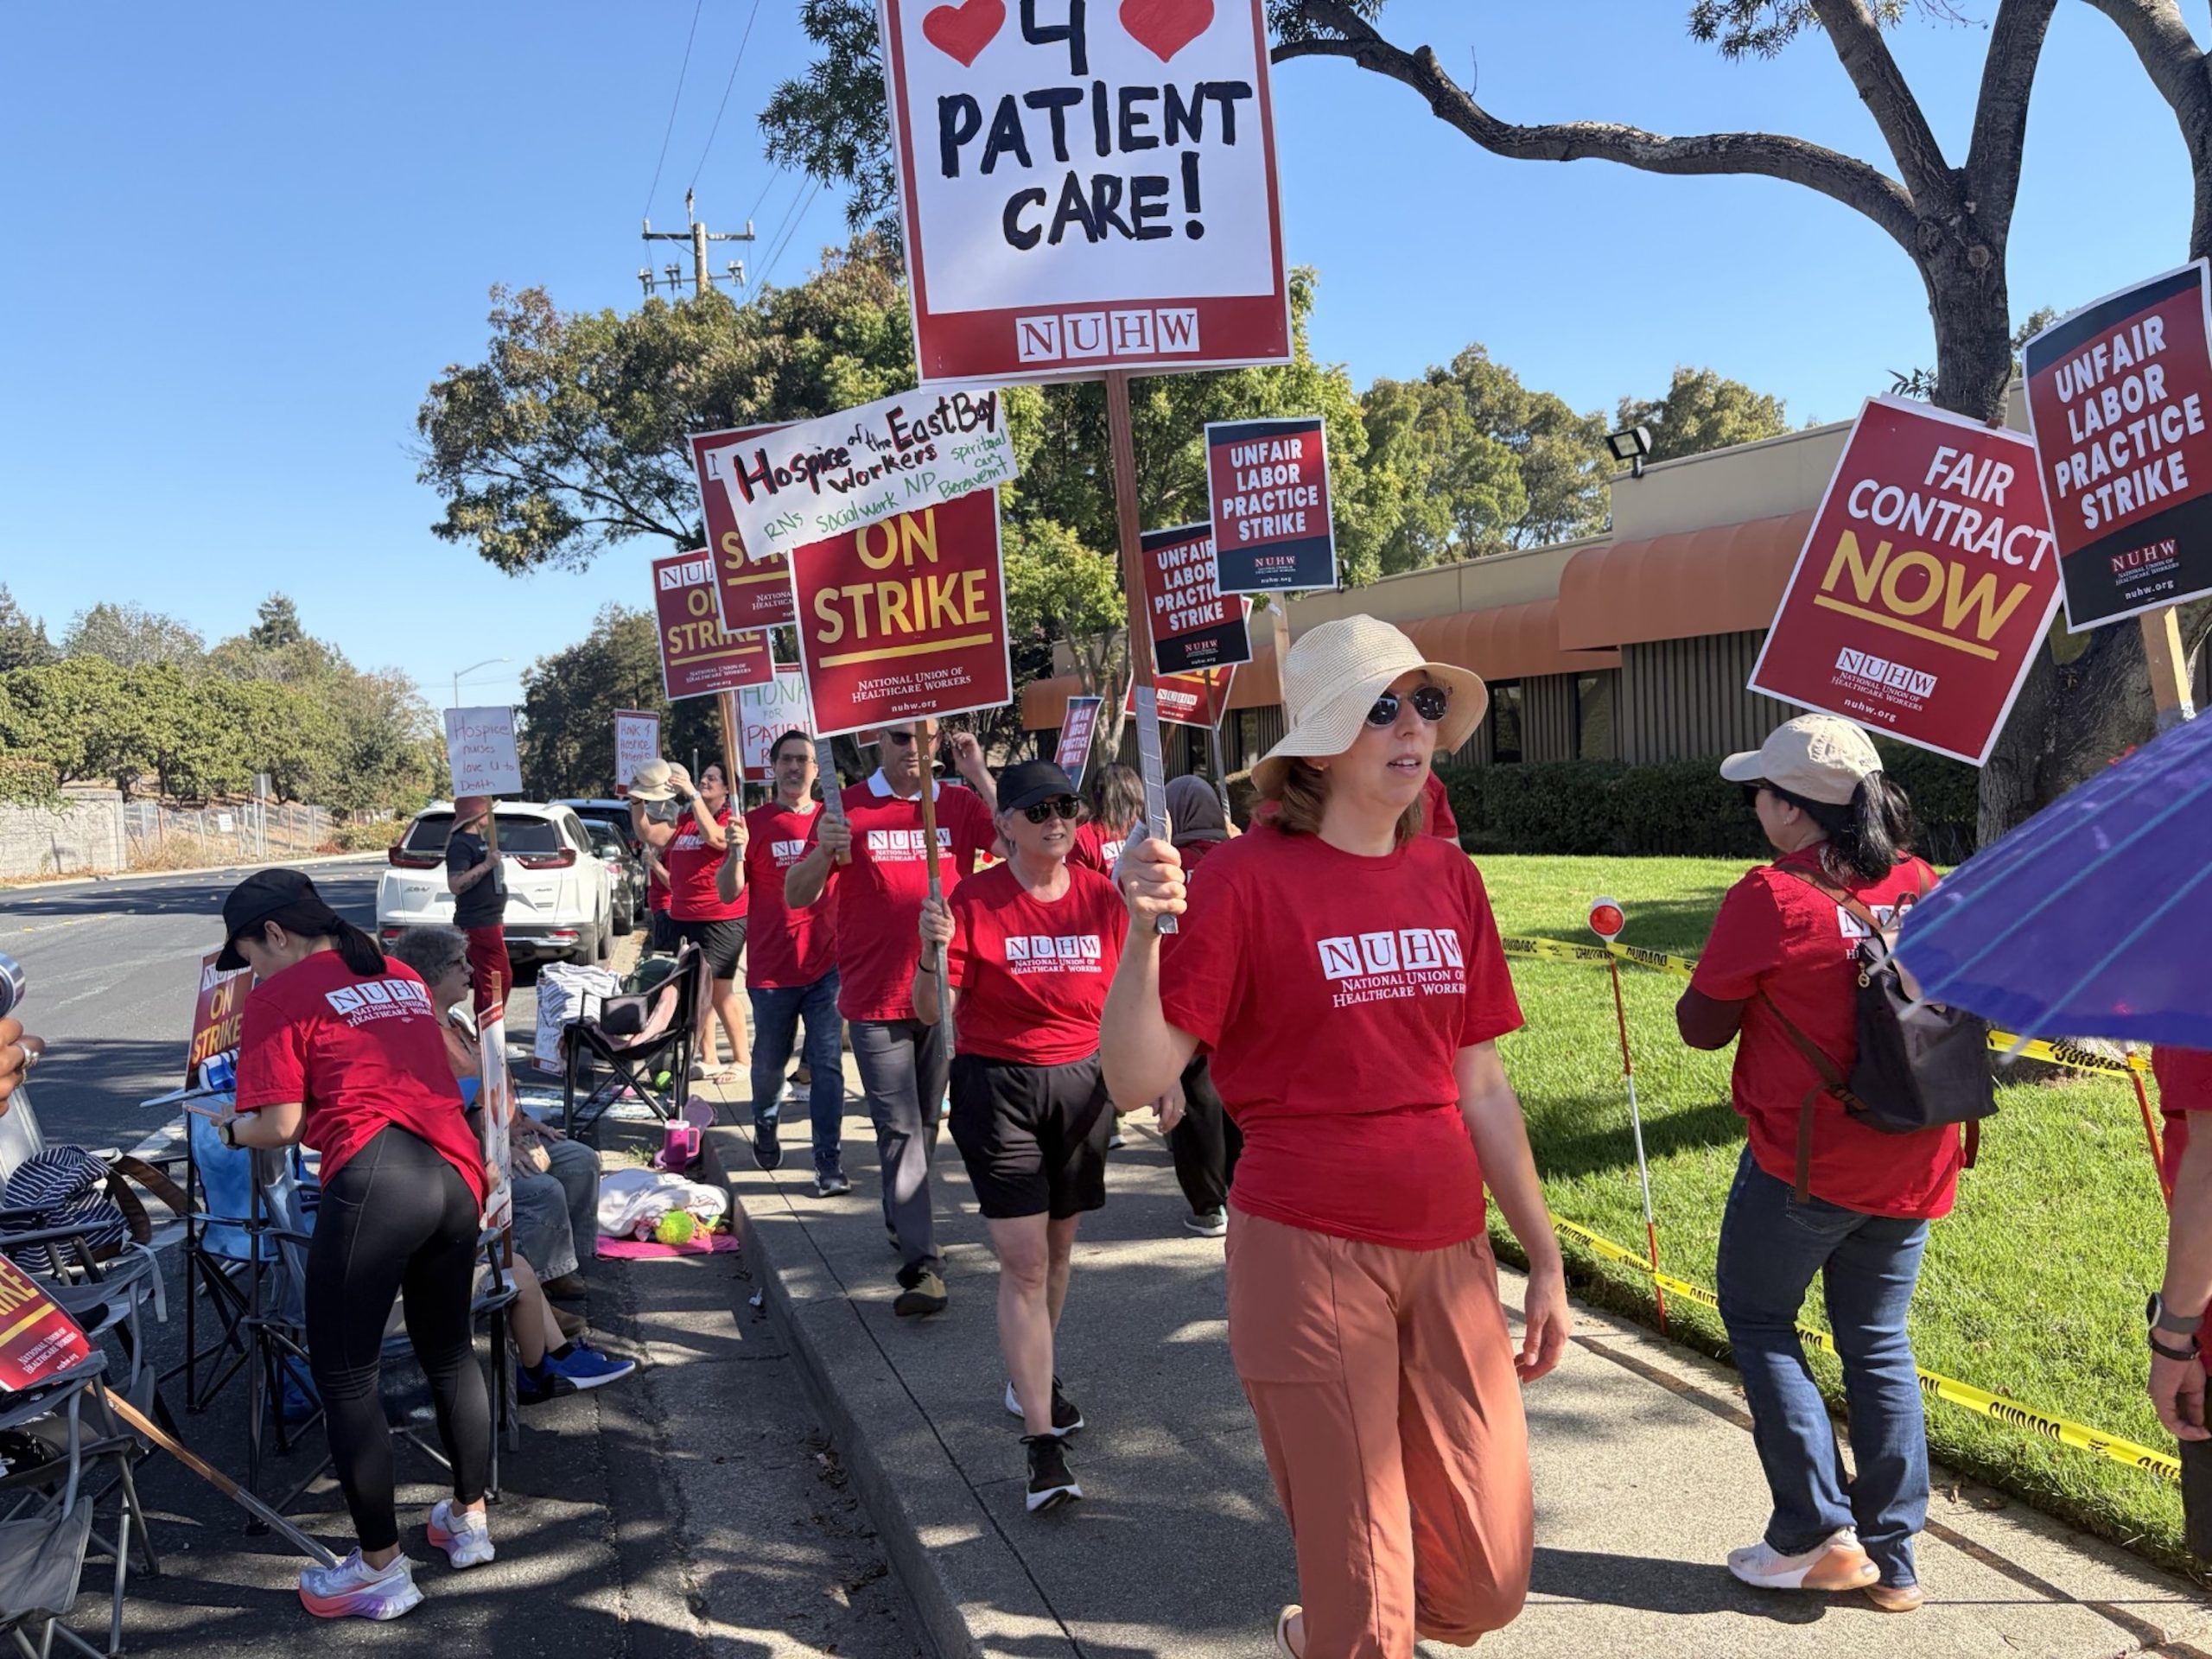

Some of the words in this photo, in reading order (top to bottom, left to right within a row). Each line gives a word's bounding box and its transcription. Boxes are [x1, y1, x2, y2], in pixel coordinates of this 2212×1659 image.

[1019, 0, 1089, 76] 4
[938, 80, 1253, 179] PATIENT
[1002, 151, 1205, 251] CARE!
[1020, 311, 1197, 359] NUHW
[2055, 315, 2166, 403] UNFAIR
[2067, 363, 2168, 444] LABOR
[1230, 438, 1303, 469] UNFAIR
[2055, 393, 2205, 499] PRACTICE
[733, 446, 852, 505] Hospice
[847, 423, 862, 446] of
[865, 429, 893, 452] the
[1236, 463, 1300, 493] LABOR
[1923, 445, 2015, 508] FAIR
[1222, 485, 1319, 519] PRACTICE
[2081, 450, 2189, 531] STRIKE
[764, 512, 804, 542] RNs
[904, 472, 936, 499] NP
[855, 508, 938, 570] ON
[1238, 511, 1306, 542] STRIKE
[1847, 479, 2053, 572] CONTRACT
[1156, 539, 1215, 570] UNFAIR
[1255, 556, 1296, 568] NUHW
[2111, 538, 2177, 572] NUHW
[1163, 561, 1216, 591] LABOR
[1821, 529, 2033, 641] NOW
[2125, 580, 2174, 600] nuhw.org
[756, 590, 792, 604] NATIONA
[813, 569, 991, 645] STRIKE
[1169, 601, 1224, 632] STRIKE
[1184, 639, 1218, 652] NUHW
[858, 675, 913, 692] NATIONAL
[914, 669, 950, 683] UNION
[950, 666, 963, 676] OF
[1838, 650, 1936, 694] NUHW
[1839, 671, 1880, 690] NATIONAL
[1882, 685, 1909, 700] UNION
[1909, 694, 1921, 702] OF
[851, 683, 922, 704] HEALTHCARE
[924, 675, 972, 692] WORKERS
[1158, 690, 1196, 705] NUHW
[1831, 676, 1885, 699] HEALTHCARE
[1885, 694, 1923, 712] WORKERS
[891, 700, 938, 713] nuhw.org
[1844, 698, 1897, 723] nuhw.org
[453, 714, 511, 744] Hospice
[1007, 938, 1099, 958] NUHW
[1014, 959, 1058, 968] NATIONAL
[1010, 966, 1065, 975] HEALTHCARE
[1341, 974, 1405, 994] NATIONAL
[1404, 969, 1451, 985] UNION
[210, 979, 235, 1020] ON
[350, 1001, 399, 1018] NATIONAL
[397, 1000, 424, 1010] UNION
[1332, 986, 1416, 1008] HEALTHCARE
[346, 1007, 409, 1028] HEALTHCARE
[191, 1013, 244, 1065] STRIKE
